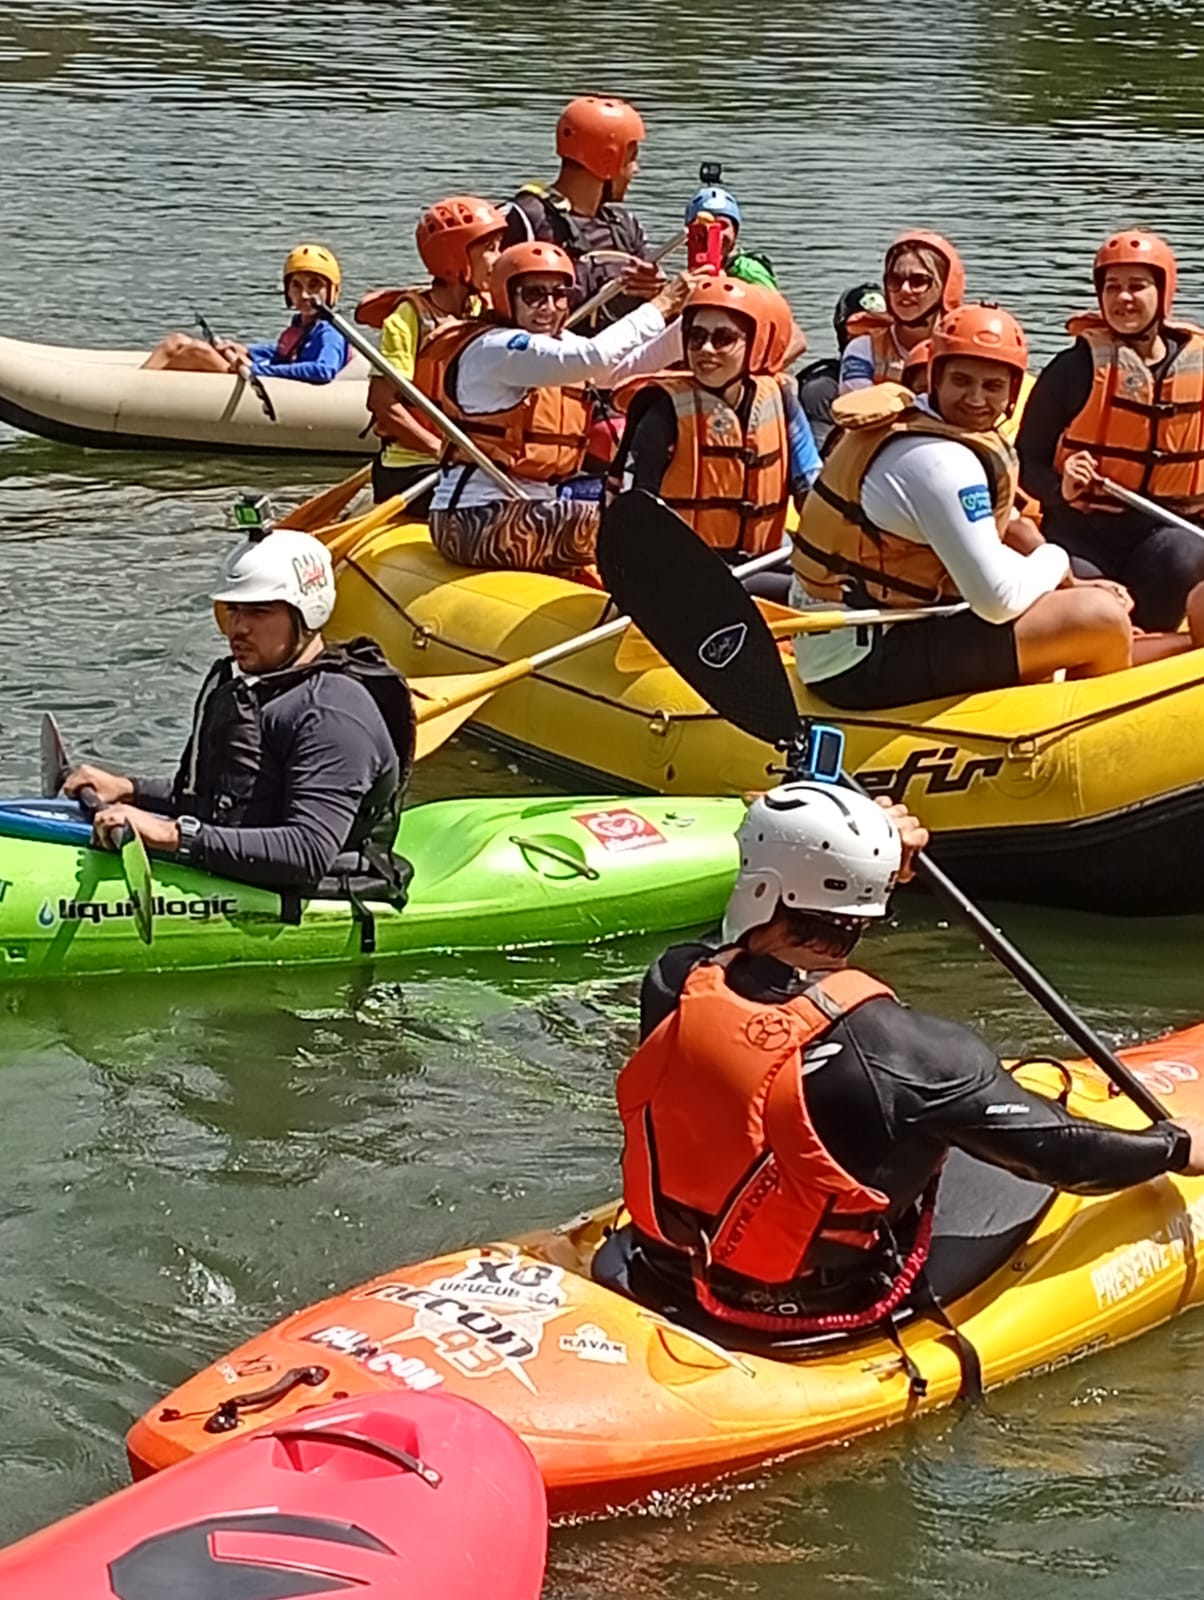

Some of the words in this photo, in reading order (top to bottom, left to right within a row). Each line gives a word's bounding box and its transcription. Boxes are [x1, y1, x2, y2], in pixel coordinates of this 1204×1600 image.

[58, 895, 239, 924] liquilogic
[1090, 1231, 1171, 1311] PRESERVE
[439, 1281, 560, 1308] URUCUBCA
